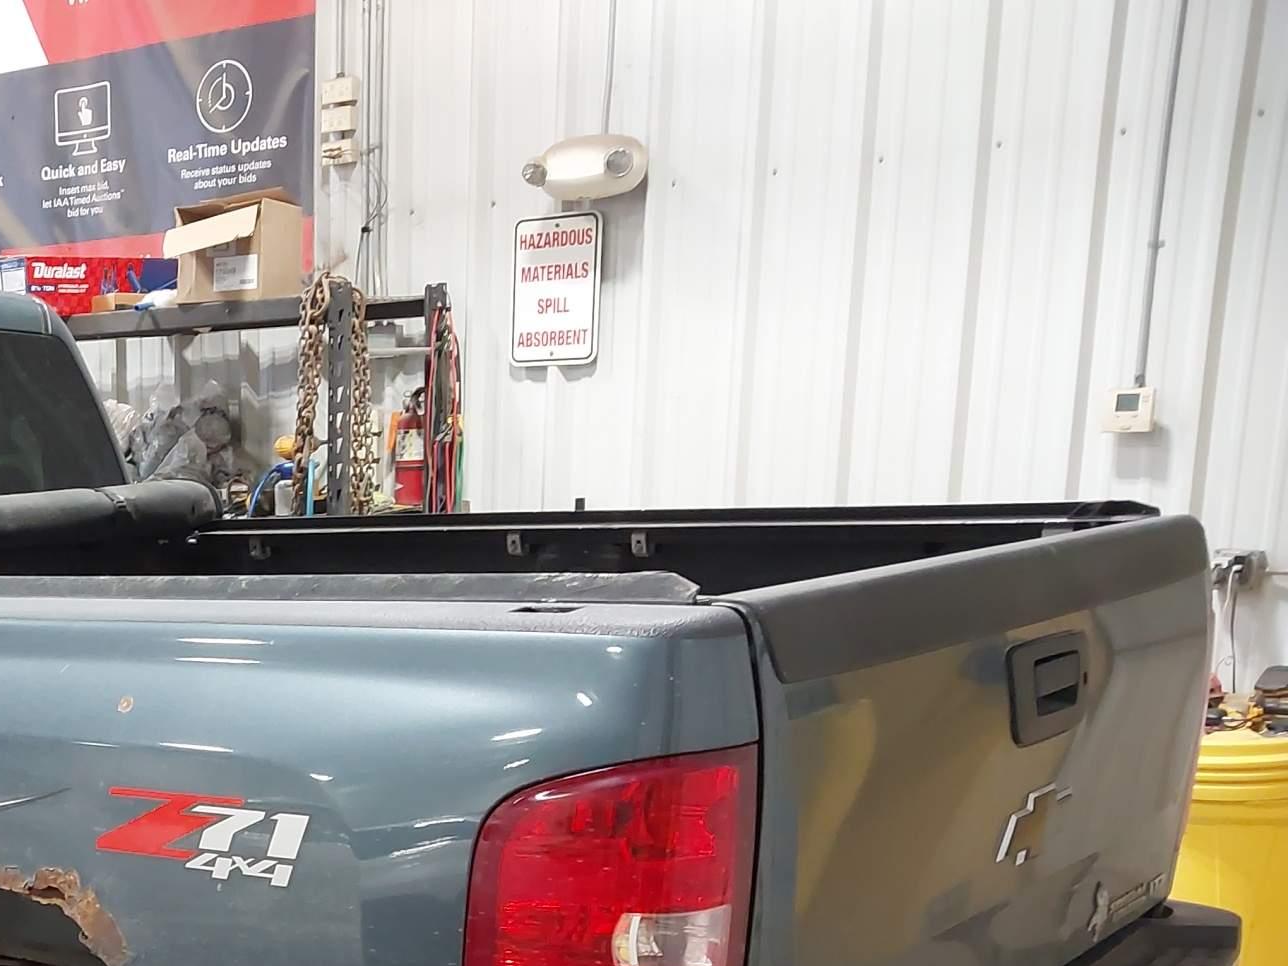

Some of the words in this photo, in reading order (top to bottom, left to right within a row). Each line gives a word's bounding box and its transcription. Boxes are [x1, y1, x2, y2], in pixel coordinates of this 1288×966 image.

[168, 143, 228, 163] Real-Time
[231, 135, 288, 156] Updates
[41, 163, 76, 181] Quick
[77, 160, 98, 177] and
[100, 158, 126, 173] Easy
[181, 166, 210, 179] Receive
[211, 163, 236, 176] status
[238, 159, 272, 173] updates
[59, 185, 80, 196] Insert
[194, 177, 216, 190] about
[217, 176, 237, 188] your
[239, 172, 257, 184] bids
[42, 199, 52, 209] let
[54, 198, 69, 208] IAA
[69, 193, 91, 206] Timed
[67, 208, 79, 218] bid
[80, 206, 90, 216] for
[90, 205, 103, 217] you
[519, 227, 593, 250] HAZARDOUS
[31, 261, 87, 280] Duralast
[521, 261, 589, 283] MATERIALS
[537, 297, 569, 315] SPILL
[517, 329, 588, 348] ABSORBENT
[95, 786, 310, 861] Z71
